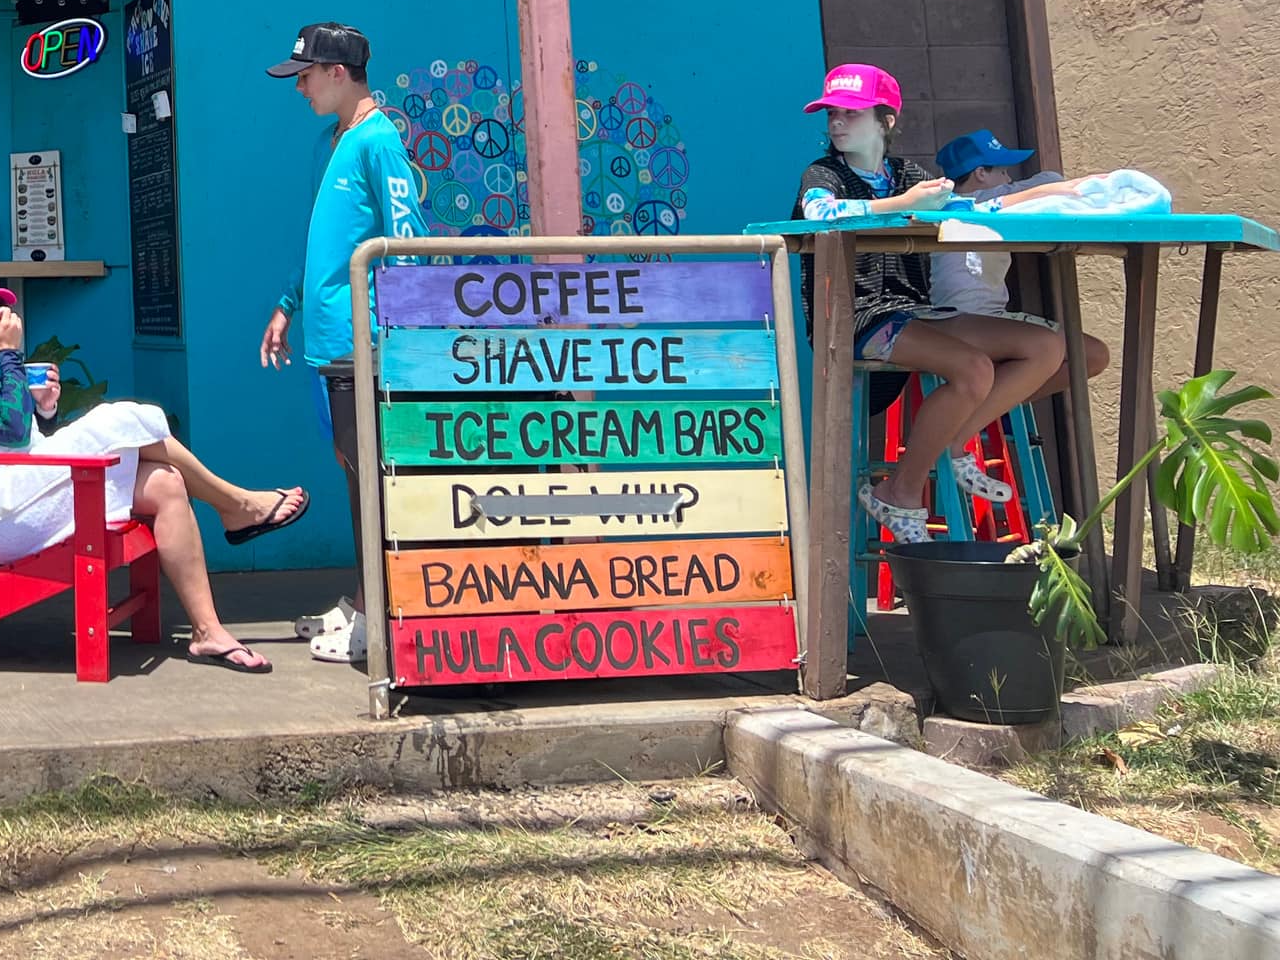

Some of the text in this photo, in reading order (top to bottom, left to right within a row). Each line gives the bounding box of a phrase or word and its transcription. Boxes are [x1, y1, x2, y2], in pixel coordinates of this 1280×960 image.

[23, 24, 99, 71] OPEN
[453, 269, 644, 318] COFFEE
[452, 335, 687, 385] SHAVE ICE
[425, 408, 766, 460] ICE CREAM BARS
[422, 553, 740, 608] BANANA BREAD
[414, 616, 741, 674] HULA COOKIES
